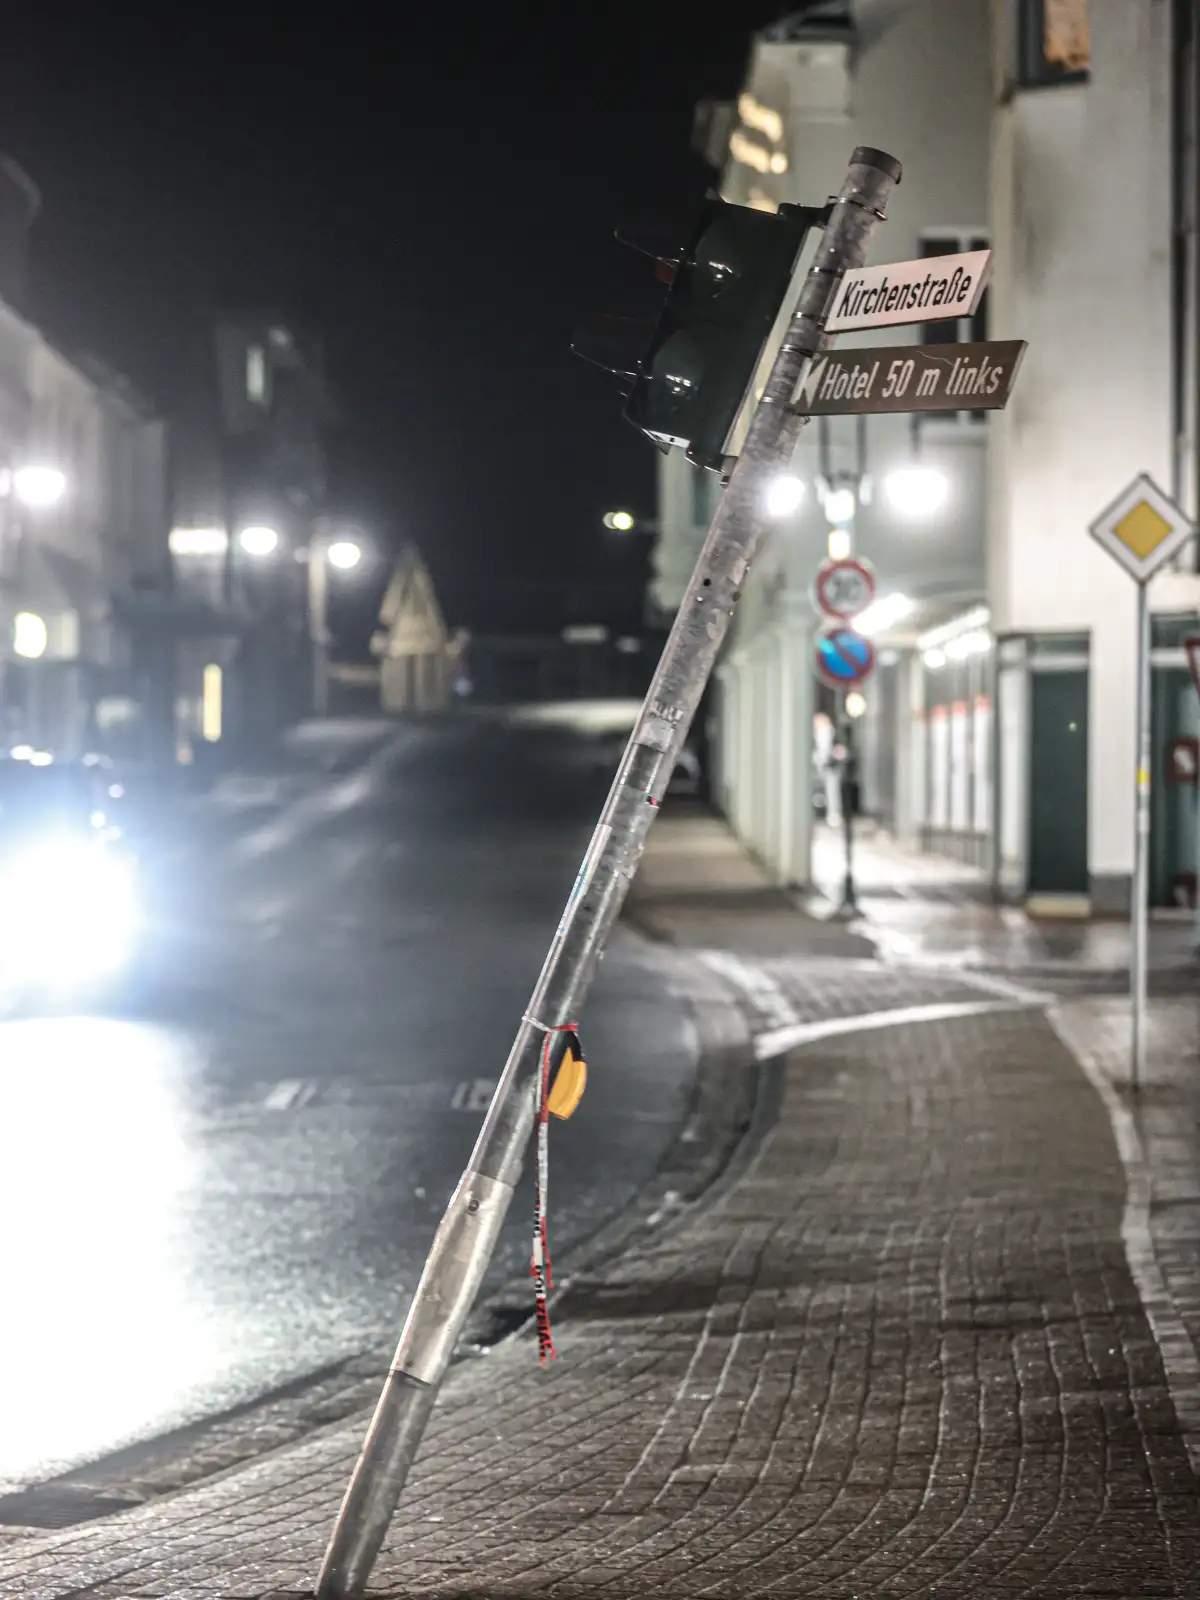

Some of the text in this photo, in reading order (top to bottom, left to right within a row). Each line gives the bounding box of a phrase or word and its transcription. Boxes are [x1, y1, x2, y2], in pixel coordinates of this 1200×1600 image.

[837, 266, 972, 318] Kirchenstraße
[819, 355, 1003, 400] Hotel 50 m links
